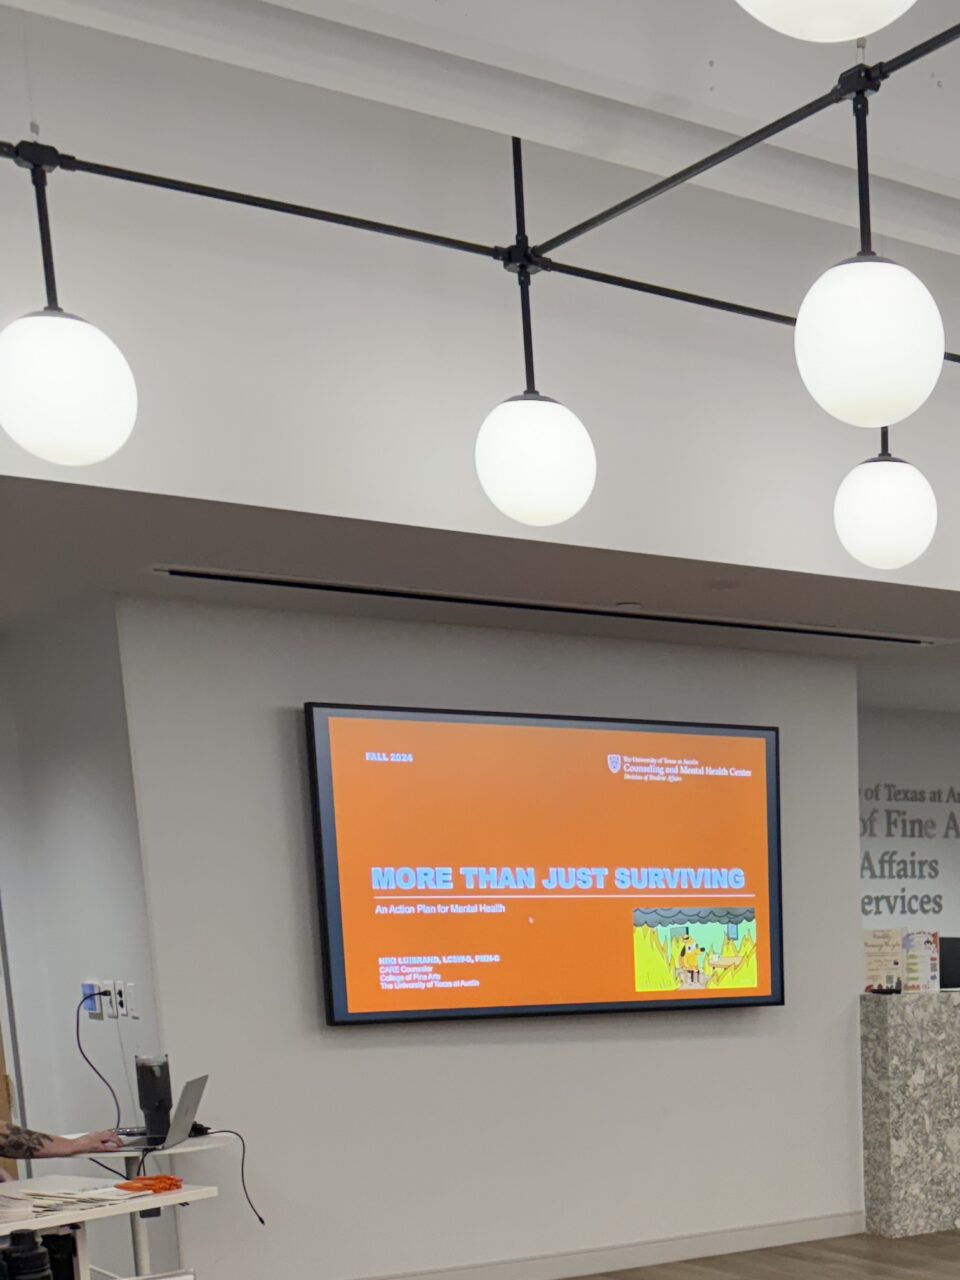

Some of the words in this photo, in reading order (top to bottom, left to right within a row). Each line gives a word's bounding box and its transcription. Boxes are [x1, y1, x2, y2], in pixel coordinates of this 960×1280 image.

[365, 751, 389, 762] FALL
[390, 752, 414, 763] 2024
[623, 763, 665, 776] Counseling
[665, 765, 679, 775] and
[680, 765, 704, 775] Mental
[705, 766, 729, 776] Health
[729, 767, 752, 778] Center
[864, 783, 880, 801] of
[883, 783, 925, 802] Texas
[928, 788, 943, 803] at
[884, 809, 937, 839] Fine
[860, 850, 939, 880] Affairs
[371, 867, 454, 890] MORE
[460, 867, 535, 889] THAN
[542, 867, 609, 889] JUST
[614, 867, 745, 890] SURVIVING
[375, 905, 388, 914] An
[389, 904, 415, 914] Action
[416, 904, 436, 914] Plan
[437, 904, 449, 913] for
[450, 904, 478, 913] Mental
[479, 903, 506, 913] Health
[861, 887, 943, 917] ervices
[381, 981, 394, 990] The
[394, 980, 425, 990] University
[460, 978, 480, 987] Austin
